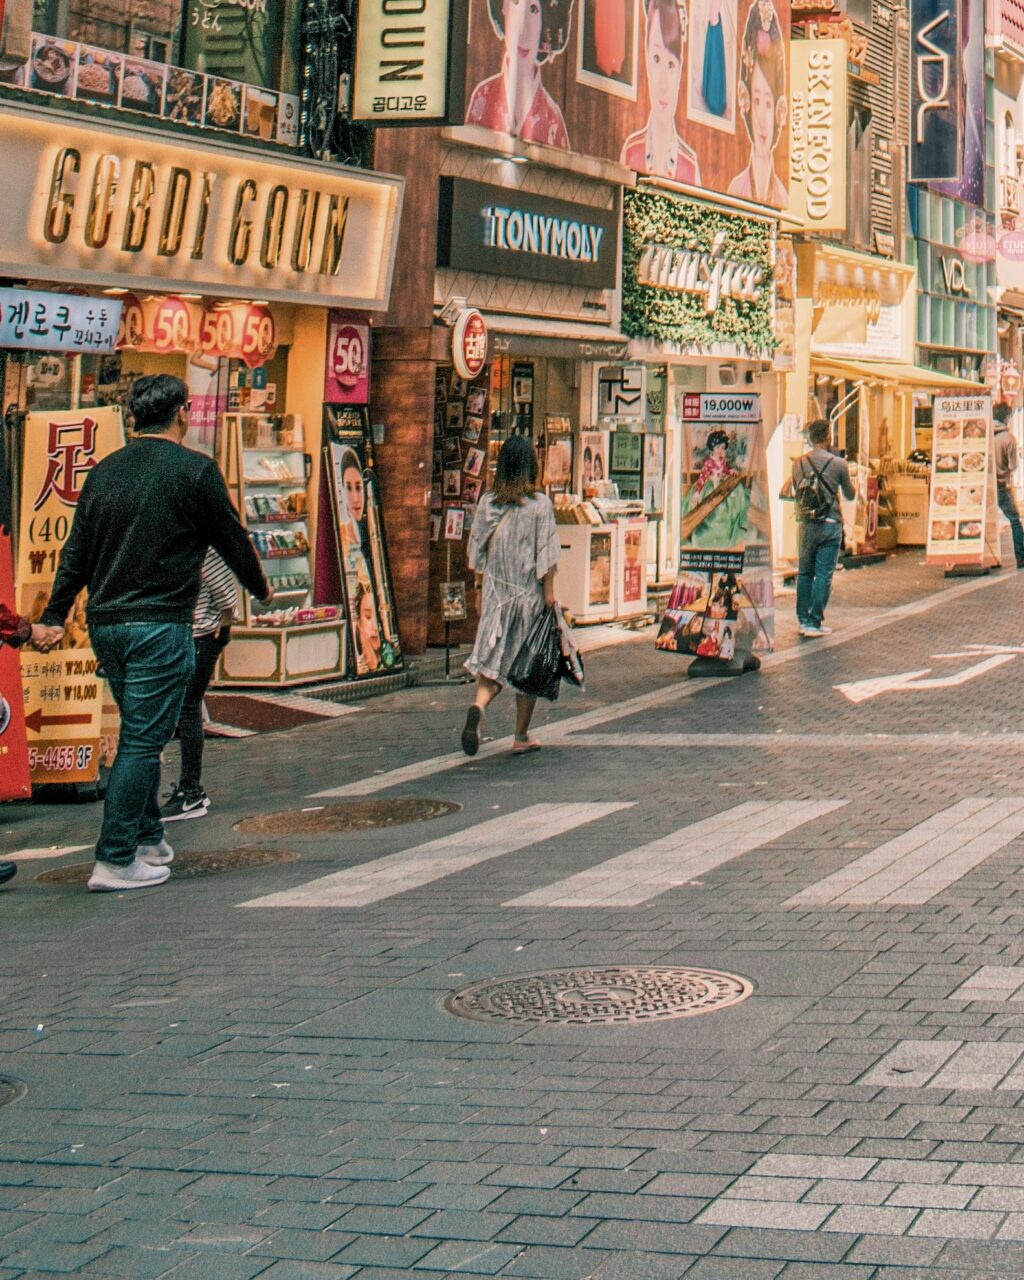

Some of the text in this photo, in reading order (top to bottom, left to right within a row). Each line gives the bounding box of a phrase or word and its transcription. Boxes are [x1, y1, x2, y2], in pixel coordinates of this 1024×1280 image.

[191, 7, 223, 32] うどん
[916, 10, 950, 145] VDL
[807, 49, 833, 220] SKINFOOD
[43, 147, 350, 277] GOBDI GOUN
[486, 208, 604, 262] TONYMOLY
[939, 255, 973, 297] VDL
[8, 301, 71, 343] 겐로쿠
[335, 336, 362, 375] 50
[34, 417, 97, 507] 足
[76, 746, 93, 769] 3F
